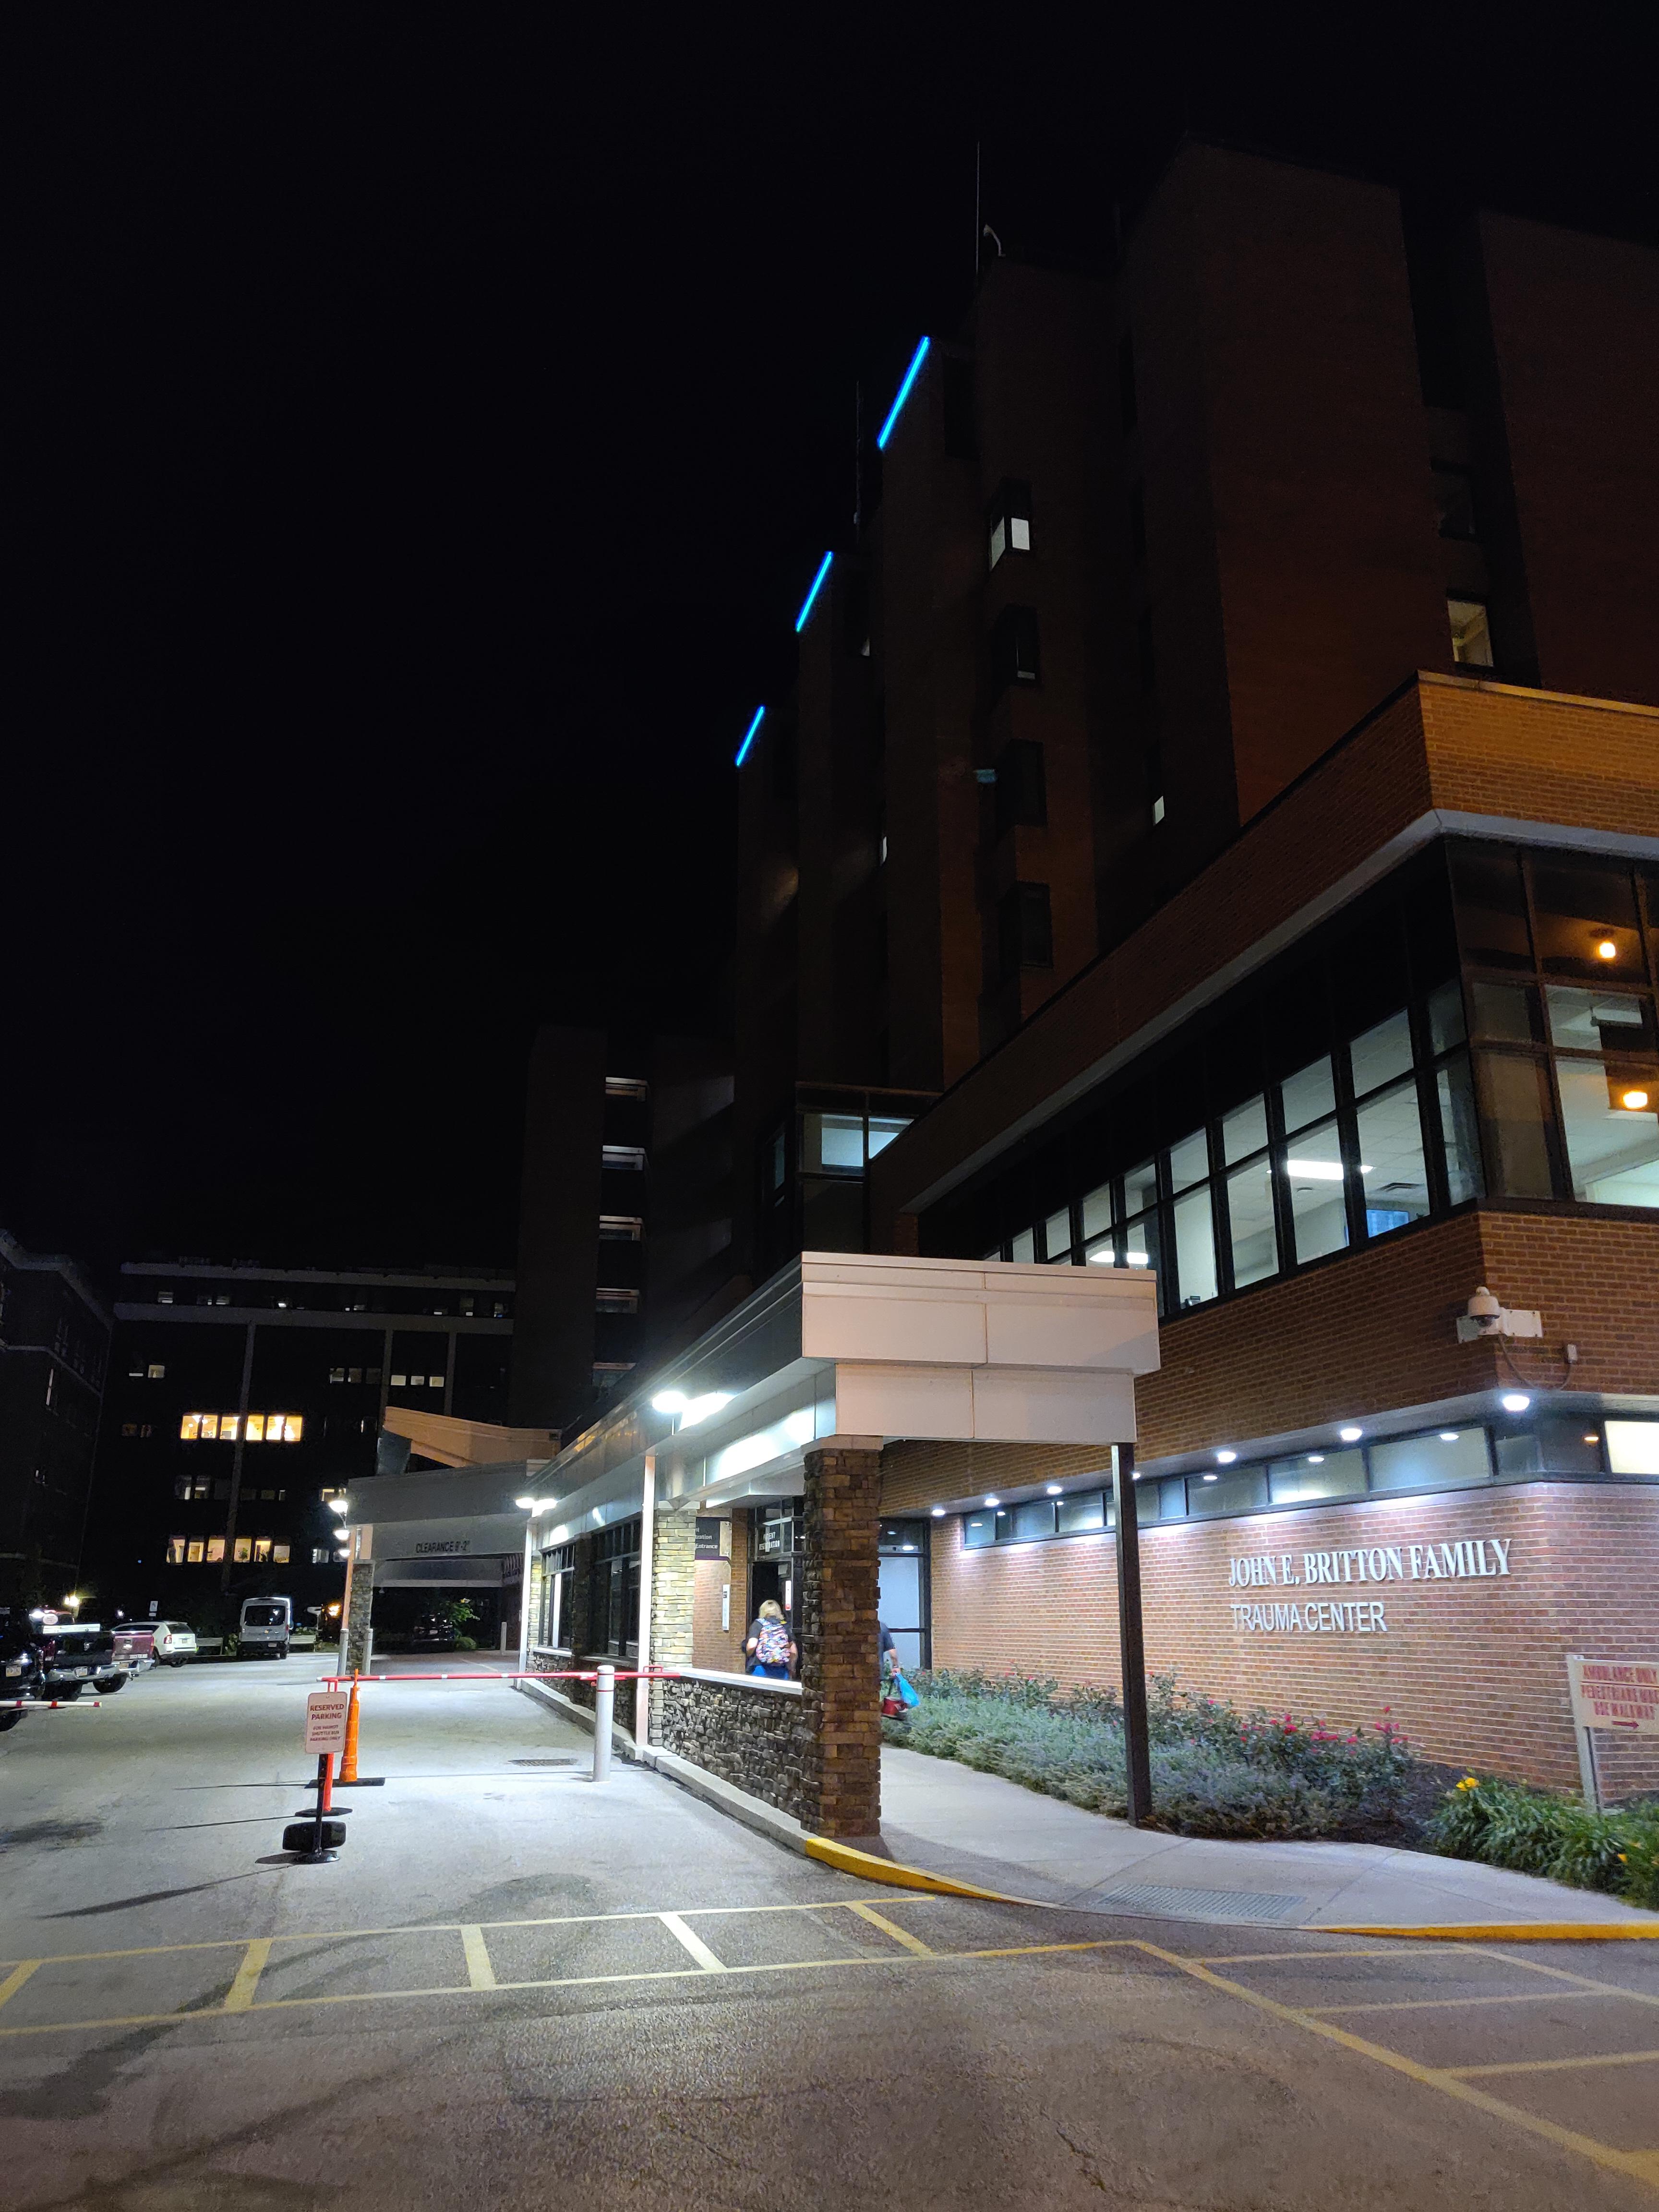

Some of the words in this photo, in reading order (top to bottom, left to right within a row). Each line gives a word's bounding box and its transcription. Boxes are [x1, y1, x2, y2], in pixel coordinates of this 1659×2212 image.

[416, 1541, 454, 1553] CLEARANCE
[1228, 1556, 1276, 1587] JOHN
[1281, 1554, 1300, 1585] E.
[1303, 1547, 1404, 1584] BRITTON
[1408, 1539, 1512, 1579] FAMILY
[1230, 1603, 1303, 1632] TRAUMA
[1305, 1601, 1388, 1632] CENTER
[312, 1712, 342, 1720] PARKING
